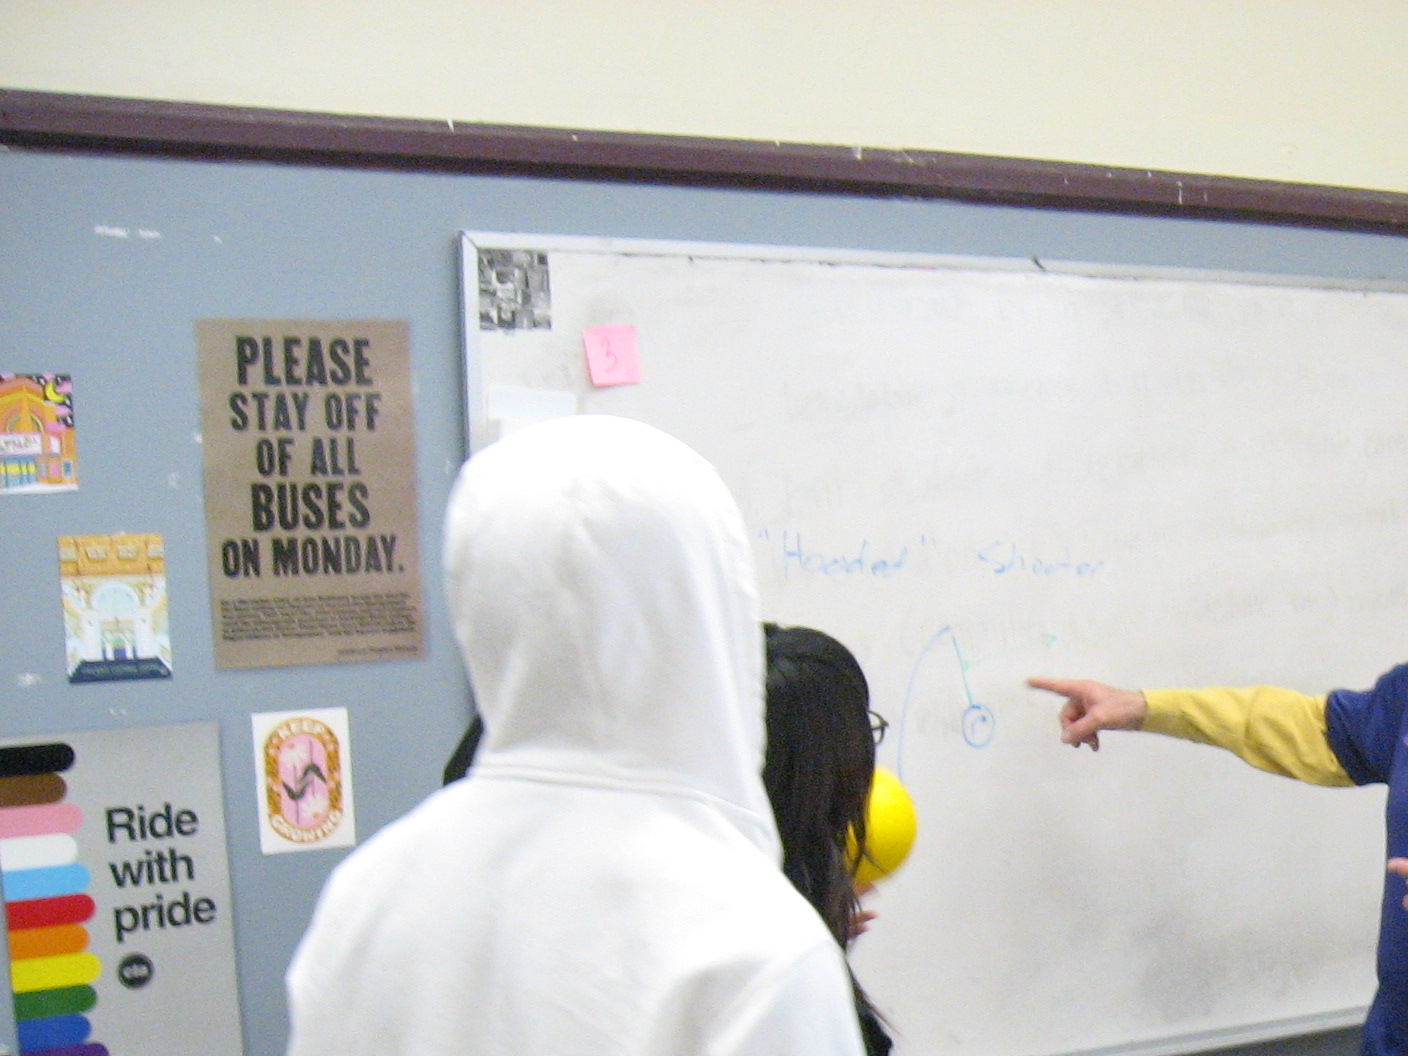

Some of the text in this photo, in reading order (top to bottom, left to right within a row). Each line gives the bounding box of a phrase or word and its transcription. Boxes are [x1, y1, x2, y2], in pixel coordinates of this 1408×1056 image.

[236, 335, 374, 386] PLEASE
[229, 391, 382, 431] STAY OFF
[256, 436, 361, 477] OF ALL
[251, 481, 371, 532] BUSES
[221, 533, 404, 578] ON MONDAY.
[105, 801, 199, 843] Ride
[108, 847, 195, 888] with
[113, 891, 217, 943] pride
